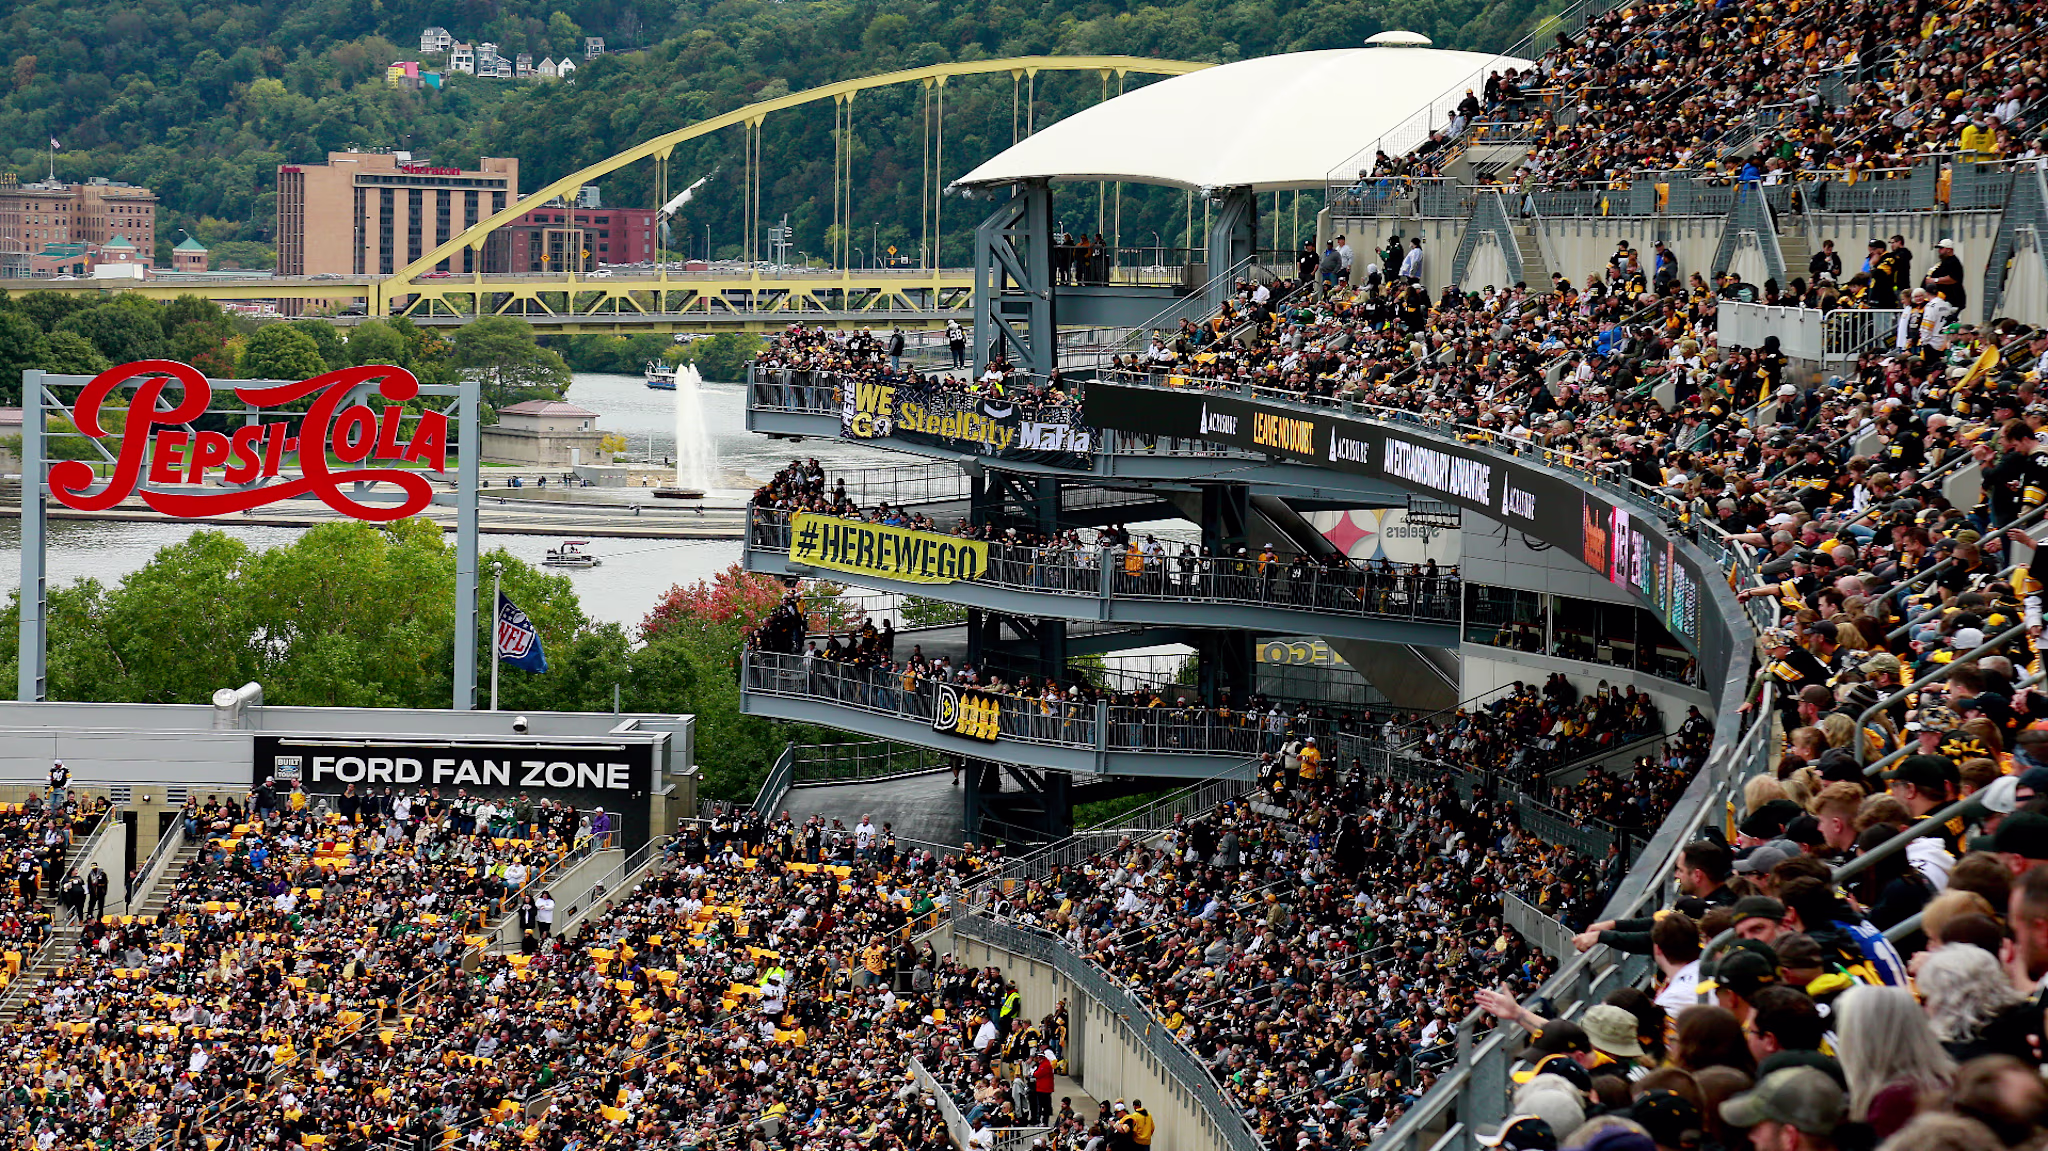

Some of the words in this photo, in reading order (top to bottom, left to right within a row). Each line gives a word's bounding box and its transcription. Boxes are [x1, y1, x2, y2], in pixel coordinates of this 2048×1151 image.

[401, 165, 461, 176] Sheraton
[950, 329, 963, 341] 58
[855, 382, 895, 415] WE
[1253, 412, 1278, 447] LEAVE
[1278, 417, 1290, 450] NO
[1289, 419, 1315, 455] DOUBT.
[1337, 437, 1369, 464] ACRISURE
[1384, 437, 1394, 474] AN
[1394, 439, 1450, 493] EXTRAORDINARY
[1449, 455, 1491, 506] ADVANTAGE
[797, 521, 977, 580] #HEREWEGO
[499, 621, 527, 652] NFL
[278, 758, 299, 766] BUILT
[312, 757, 423, 783] FORD
[433, 758, 511, 786] FAN
[520, 761, 630, 789] ZONE
[1262, 766, 1272, 777] 97
[300, 840, 313, 849] 32
[871, 954, 880, 964] 55
